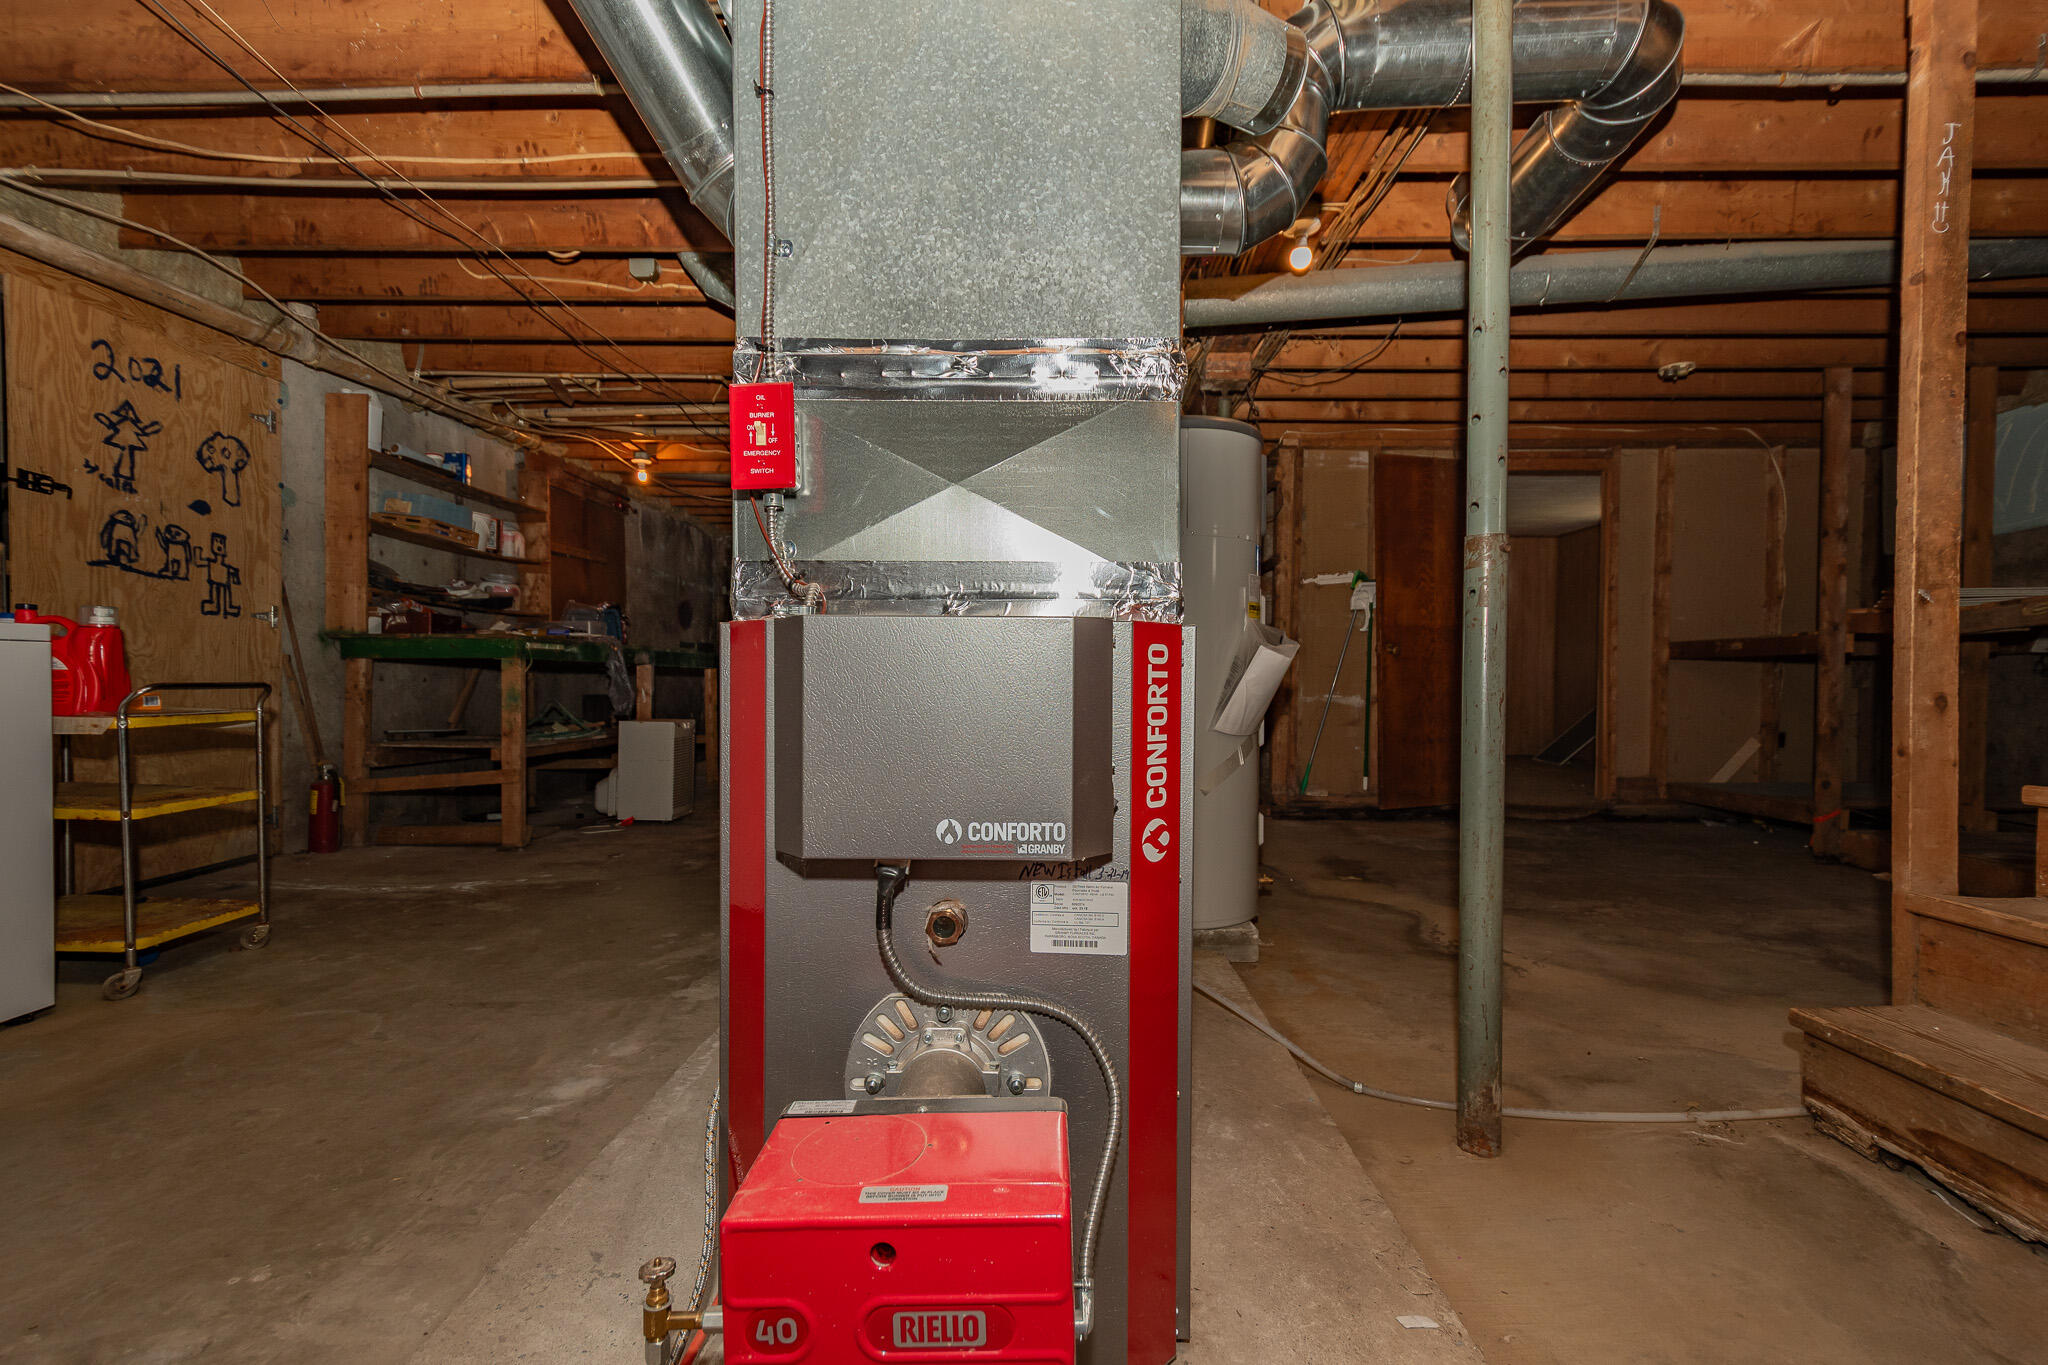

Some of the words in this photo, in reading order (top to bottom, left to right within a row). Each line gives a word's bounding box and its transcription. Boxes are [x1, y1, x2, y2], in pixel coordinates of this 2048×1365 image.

[91, 339, 182, 401] 2021
[750, 467, 775, 475] SWITCH
[1146, 643, 1169, 809] CONFORTO
[968, 822, 1066, 842] CONFORTO
[1028, 843, 1066, 854] GRANBY
[1019, 862, 1056, 880] NEW
[755, 1317, 798, 1345] 40
[900, 1315, 979, 1344] RIELLO
